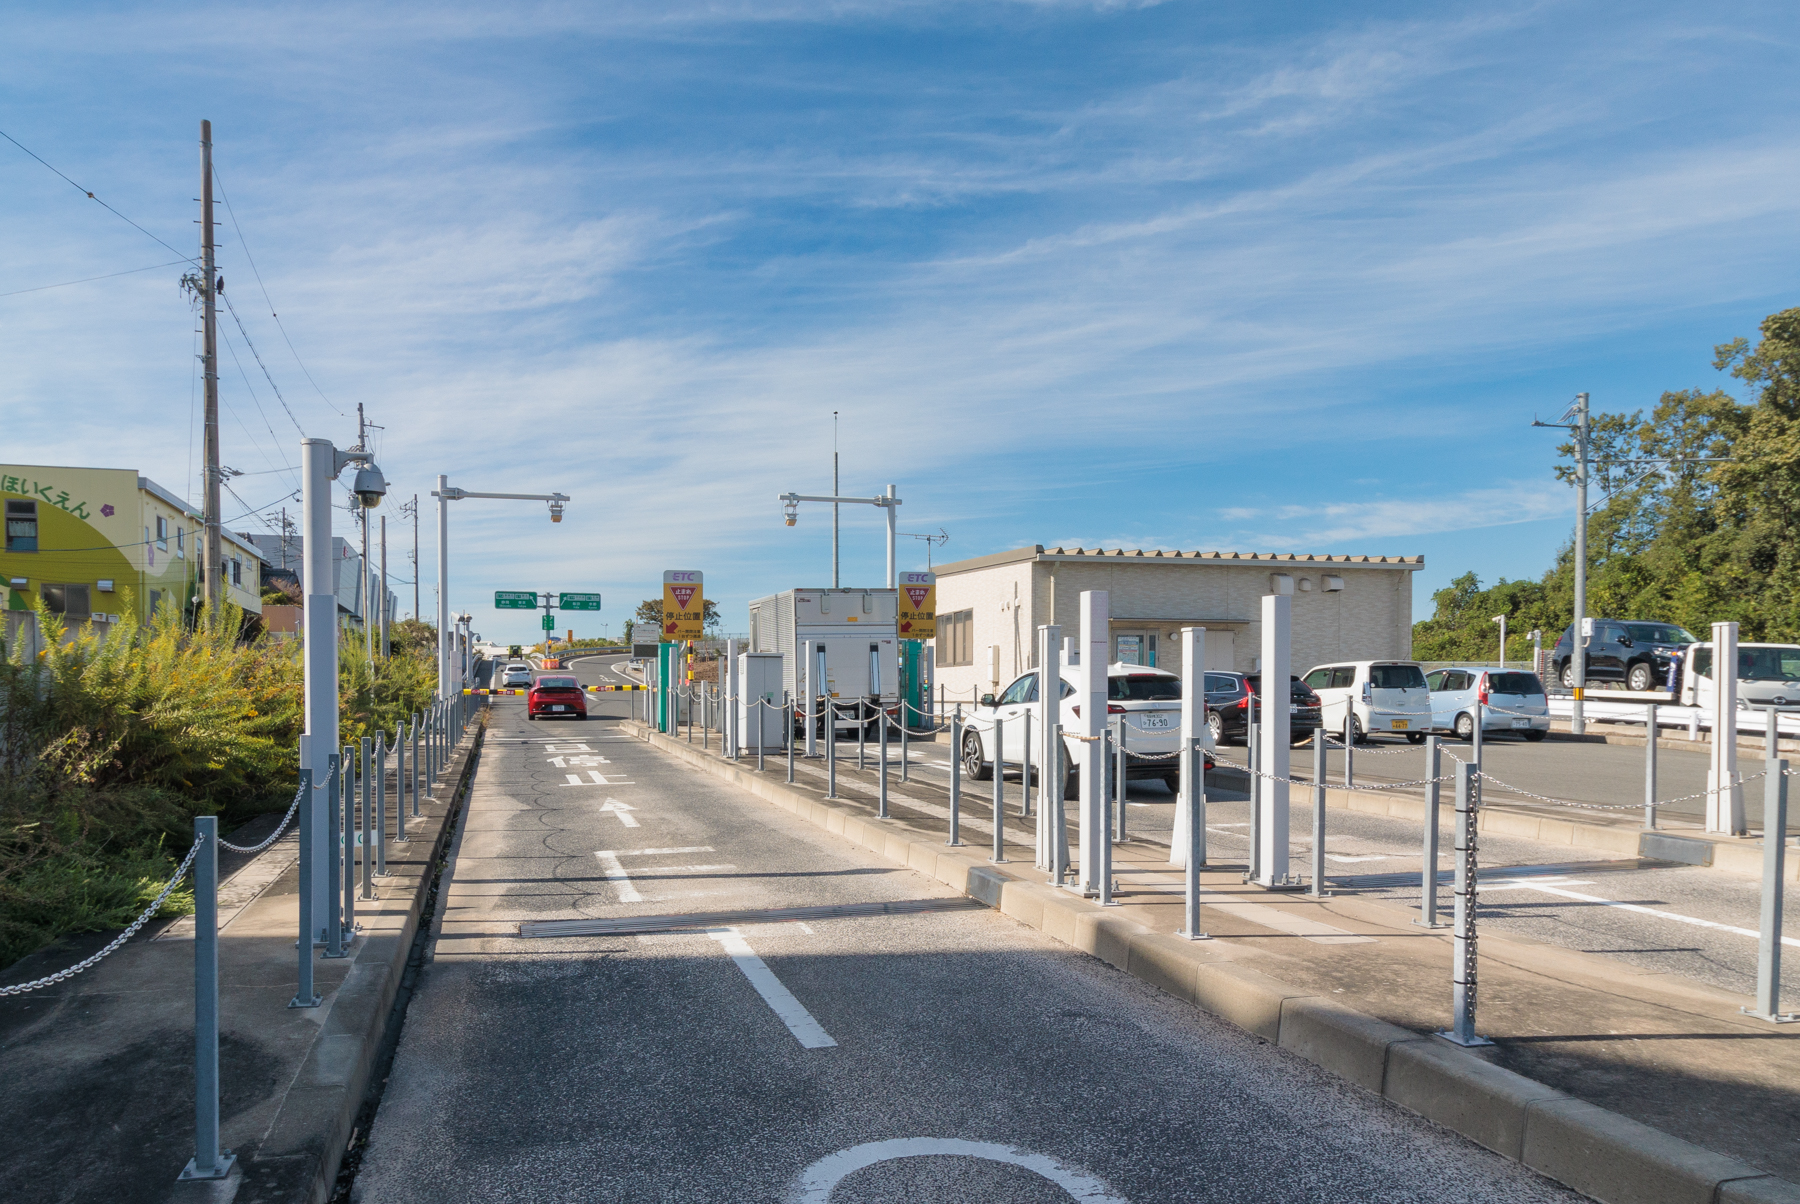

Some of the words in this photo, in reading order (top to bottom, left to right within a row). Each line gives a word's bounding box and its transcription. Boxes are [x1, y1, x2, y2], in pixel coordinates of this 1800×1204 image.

[1, 474, 91, 520] ほいくえん
[672, 572, 695, 581] ETC
[907, 574, 929, 583] ETC
[666, 612, 701, 621] 停止位置
[901, 611, 934, 620] 停止位置
[1147, 719, 1168, 727] 76-90
